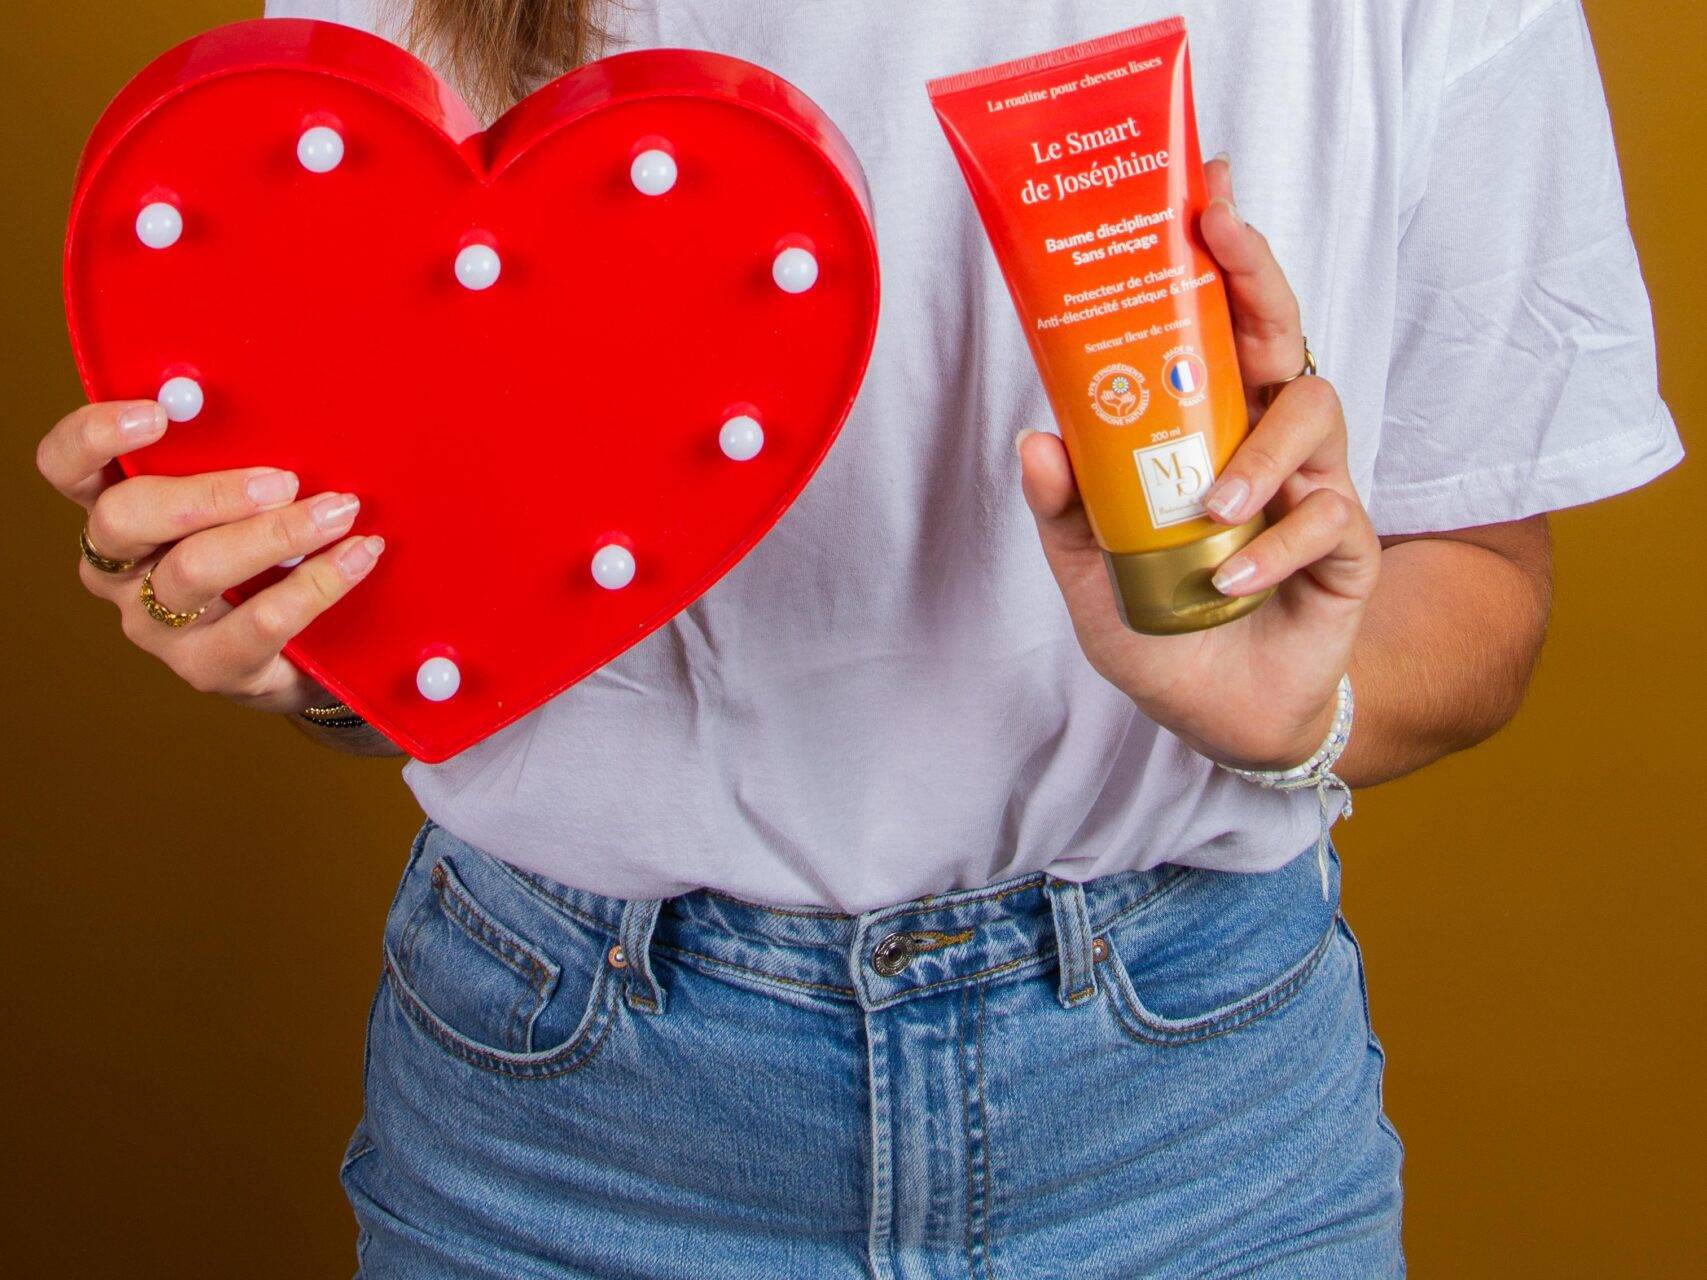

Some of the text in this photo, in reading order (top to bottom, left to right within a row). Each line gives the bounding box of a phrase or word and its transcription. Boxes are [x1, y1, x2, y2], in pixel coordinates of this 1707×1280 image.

[987, 56, 1163, 112] La routine pour cheveux lisses
[1031, 117, 1141, 164] Le Smart
[1021, 150, 1170, 205] de Joséphine
[1045, 207, 1175, 253] Baume disciplinant
[1072, 233, 1158, 266] Sans rinçage
[1037, 299, 1119, 329] Anti-électricité
[1122, 288, 1168, 309] statique
[1170, 283, 1182, 296] &
[1064, 264, 1185, 306] Protecteur de chaleur
[1085, 338, 1123, 354] Senteur
[1125, 328, 1149, 344] fleur
[1150, 323, 1164, 336] de
[1151, 430, 1169, 443] 200
